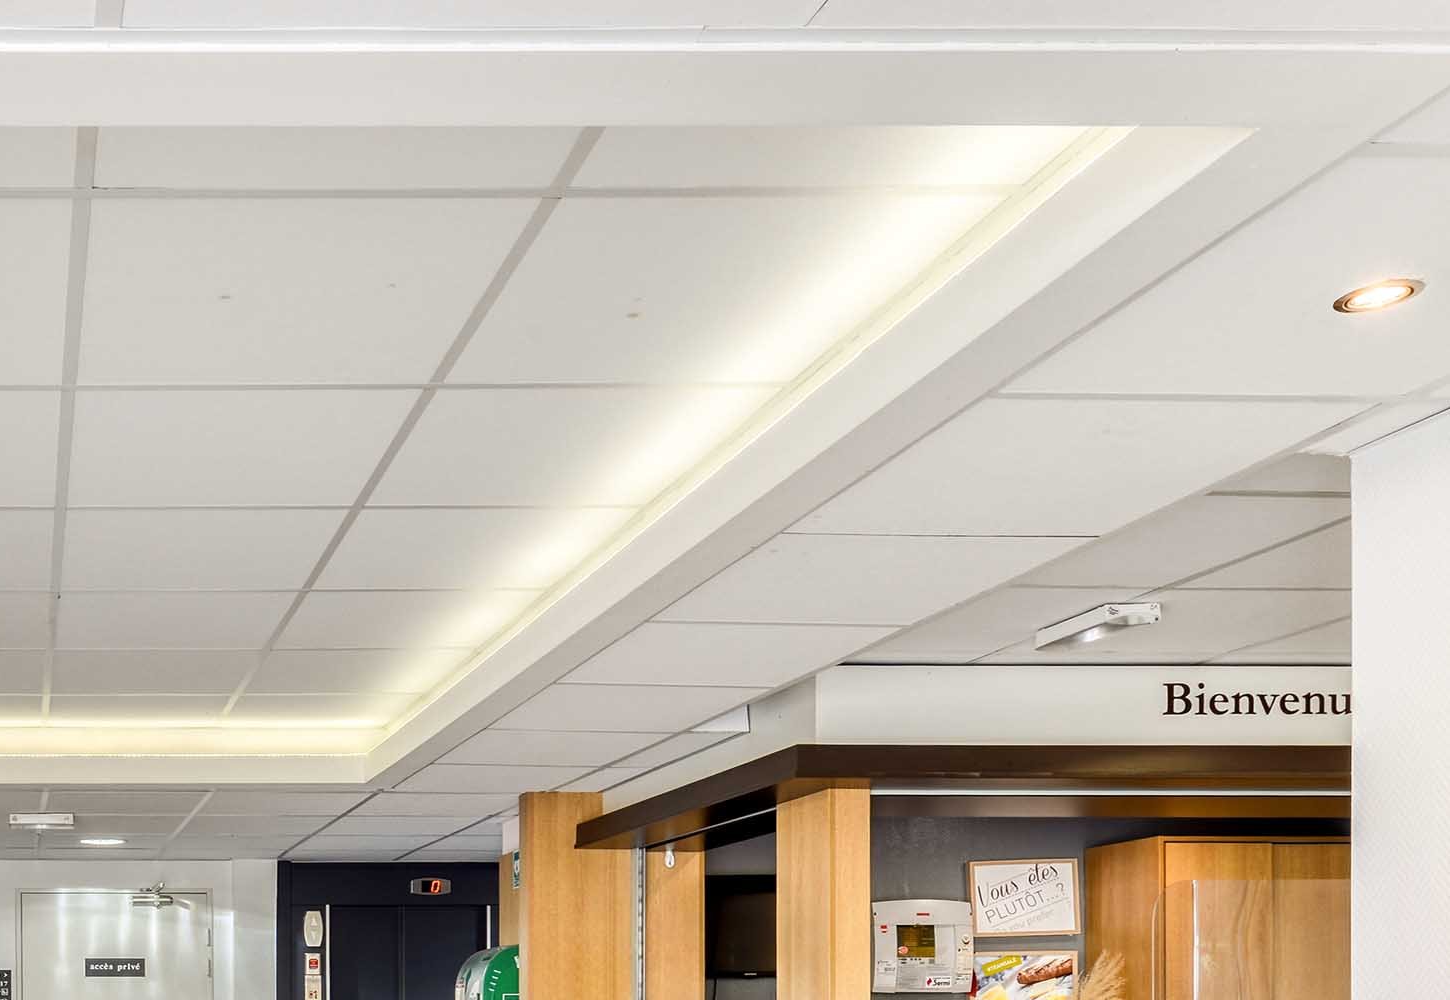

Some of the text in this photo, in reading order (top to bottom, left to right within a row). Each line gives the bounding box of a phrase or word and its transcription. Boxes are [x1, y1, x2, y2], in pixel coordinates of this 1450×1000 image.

[1162, 682, 1352, 716] Bienvenu
[431, 880, 440, 893] 0
[977, 863, 1059, 908] Vous êtes
[89, 962, 141, 972] accès privé
